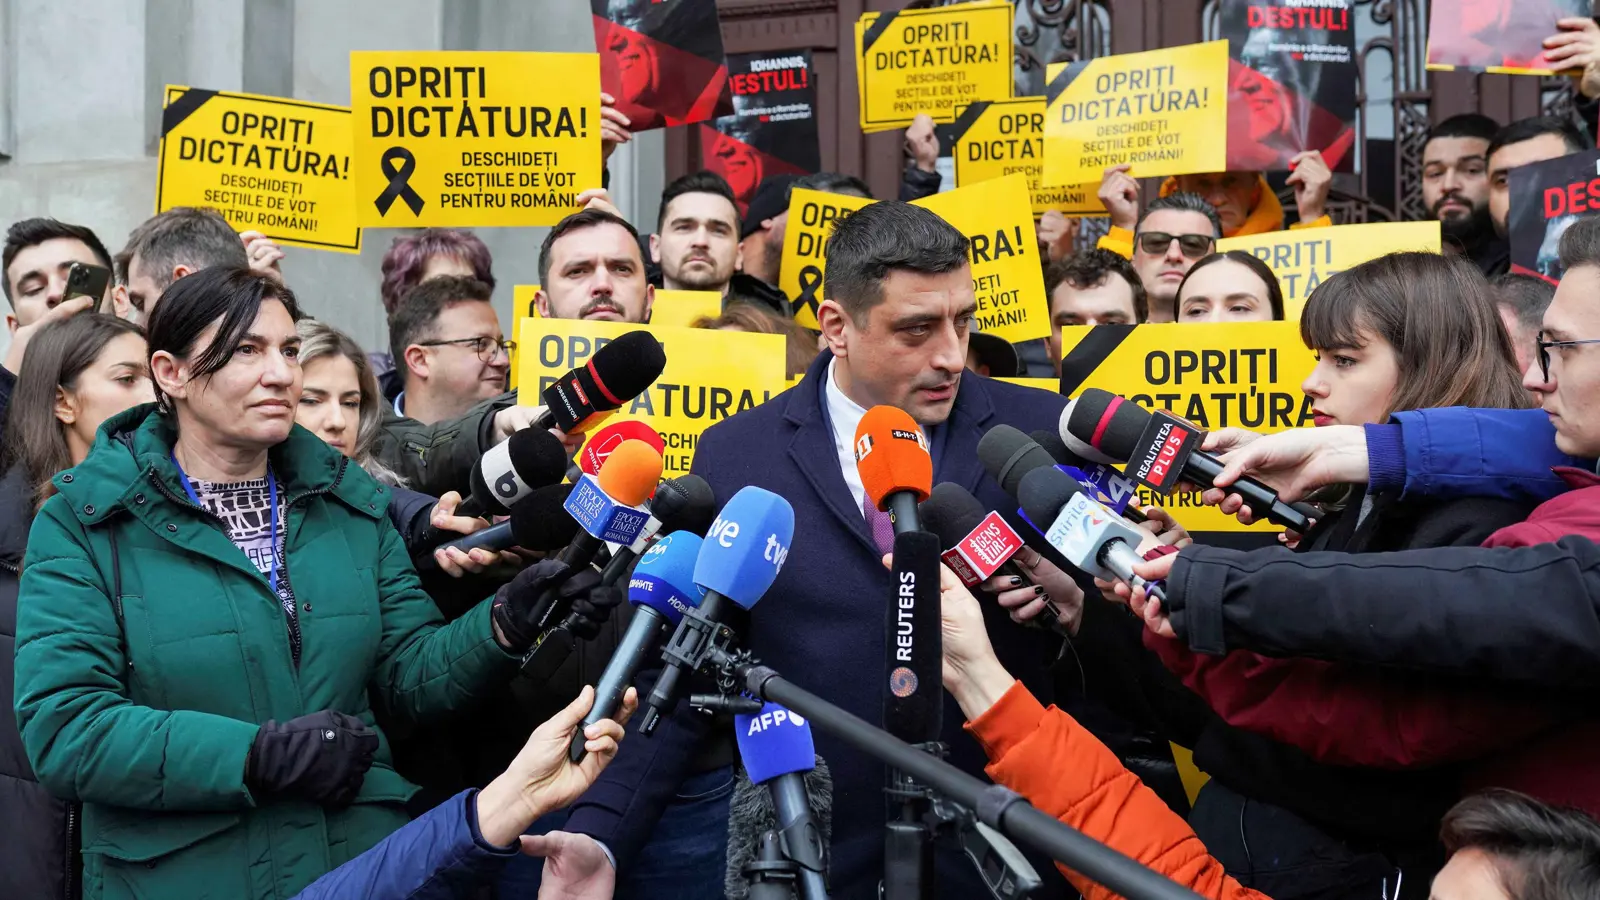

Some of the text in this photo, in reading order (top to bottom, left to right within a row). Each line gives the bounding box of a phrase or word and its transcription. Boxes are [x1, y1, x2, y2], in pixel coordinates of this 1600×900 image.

[1247, 5, 1348, 31] DESTUL!
[903, 21, 969, 47] OPRIȚI
[876, 44, 998, 71] DICTATURA!
[369, 66, 486, 107] OPRIȚI
[729, 67, 808, 95] ESTUL!
[941, 86, 953, 96] DE
[956, 84, 978, 95] VOT
[1096, 66, 1174, 93] OPRIȚI
[1062, 87, 1208, 124] DICTATURA!
[222, 111, 313, 151] OPRIȚI
[372, 106, 587, 138] DICTATURA!
[999, 113, 1044, 135] OPR
[968, 138, 1043, 162] DICTAT
[1138, 136, 1153, 147] DE
[1156, 133, 1181, 146] VOT
[179, 136, 350, 180] DICTATURA!
[462, 152, 558, 171] DESCHIDEȚI
[1079, 146, 1183, 168] PENTRU ROMÂNI!
[221, 174, 303, 197] DESCHIDEȚI
[444, 173, 576, 192] SECȚIILE DE VOT
[204, 190, 317, 214] SECȚIILE DE VOT
[441, 193, 505, 208] PENTRU
[220, 209, 318, 232] NTRU ROMÂNI!
[990, 289, 1019, 307] VOT
[1144, 348, 1278, 397] OPRIȚI
[1137, 422, 1173, 479] REALITATEA
[1154, 435, 1181, 476] PLUS
[575, 490, 600, 519] TIMES
[580, 483, 606, 511] EPOCH
[1133, 489, 1204, 507] ENTRU
[611, 520, 638, 535] TIMES
[615, 511, 643, 527] EPOCH
[707, 514, 740, 548] tve
[896, 571, 915, 661] REUTERS
[748, 710, 787, 736] AFP
